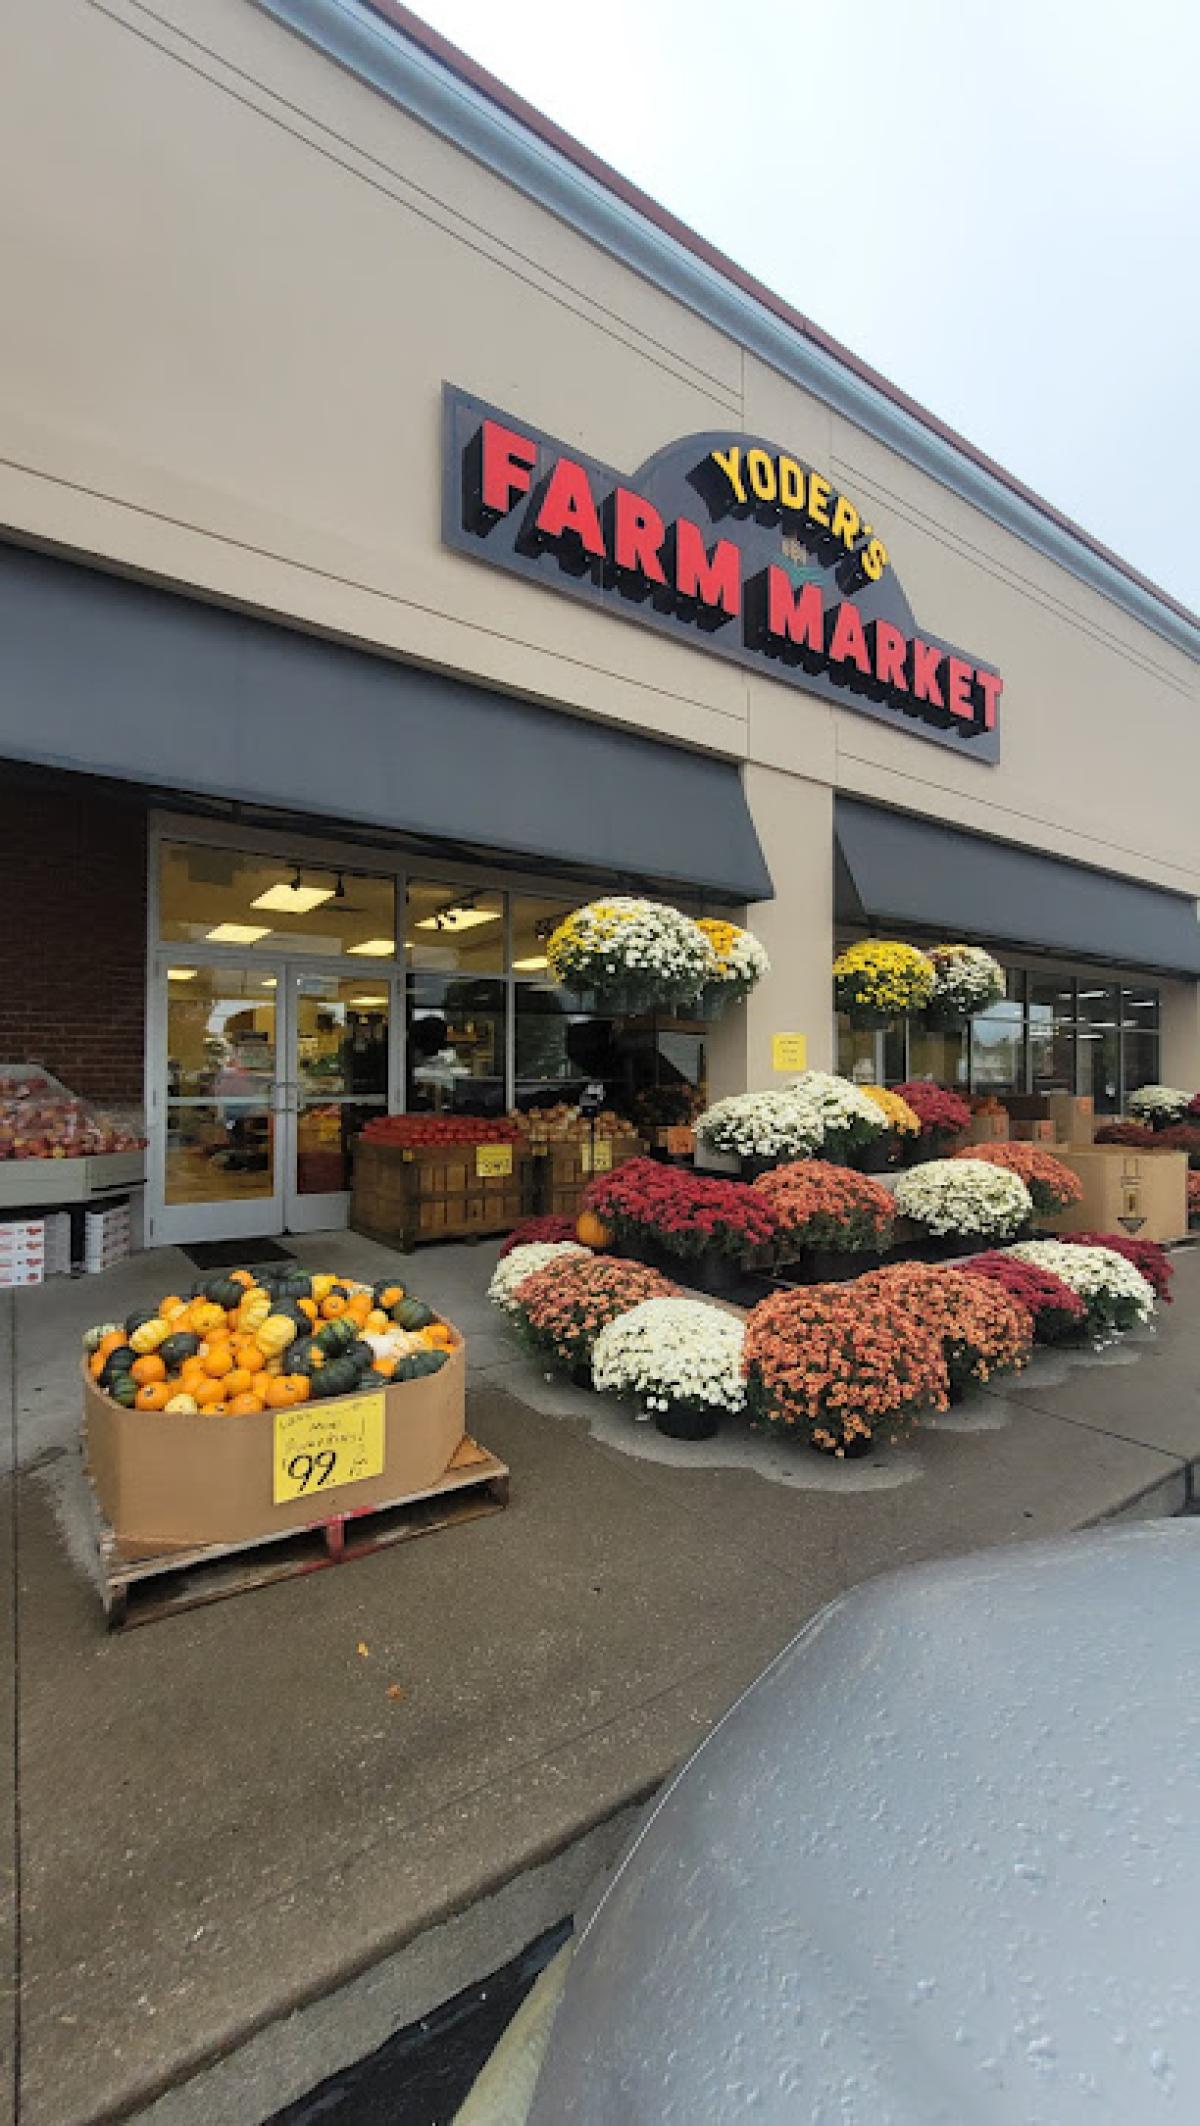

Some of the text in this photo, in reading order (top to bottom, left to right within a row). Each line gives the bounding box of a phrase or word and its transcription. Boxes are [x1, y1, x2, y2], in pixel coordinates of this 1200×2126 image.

[483, 420, 1002, 731] FARM MARKET
[711, 447, 890, 581] YODER'S
